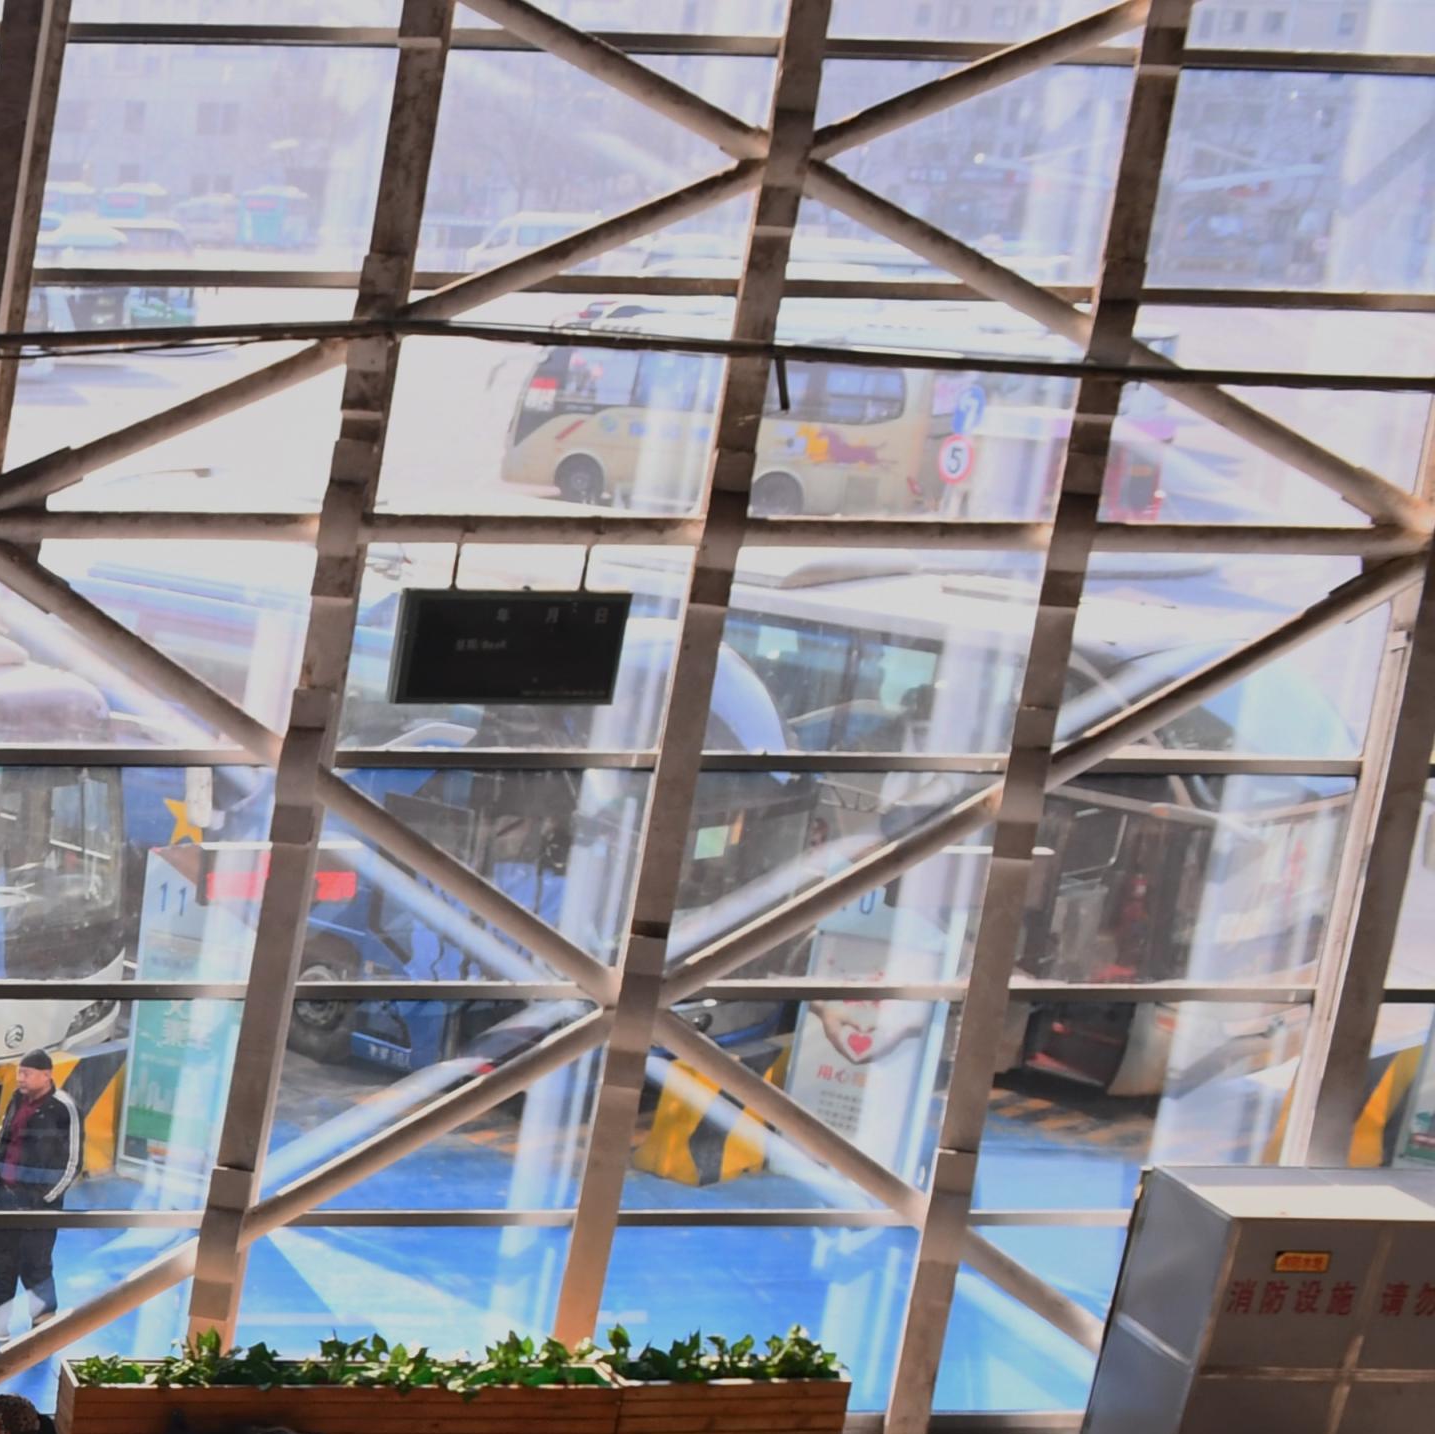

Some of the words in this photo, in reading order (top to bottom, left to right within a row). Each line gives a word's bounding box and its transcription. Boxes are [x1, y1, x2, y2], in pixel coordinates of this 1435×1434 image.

[947, 446, 963, 474] 5
[159, 881, 189, 917] 11
[1226, 1279, 1358, 1316] 消防设施
